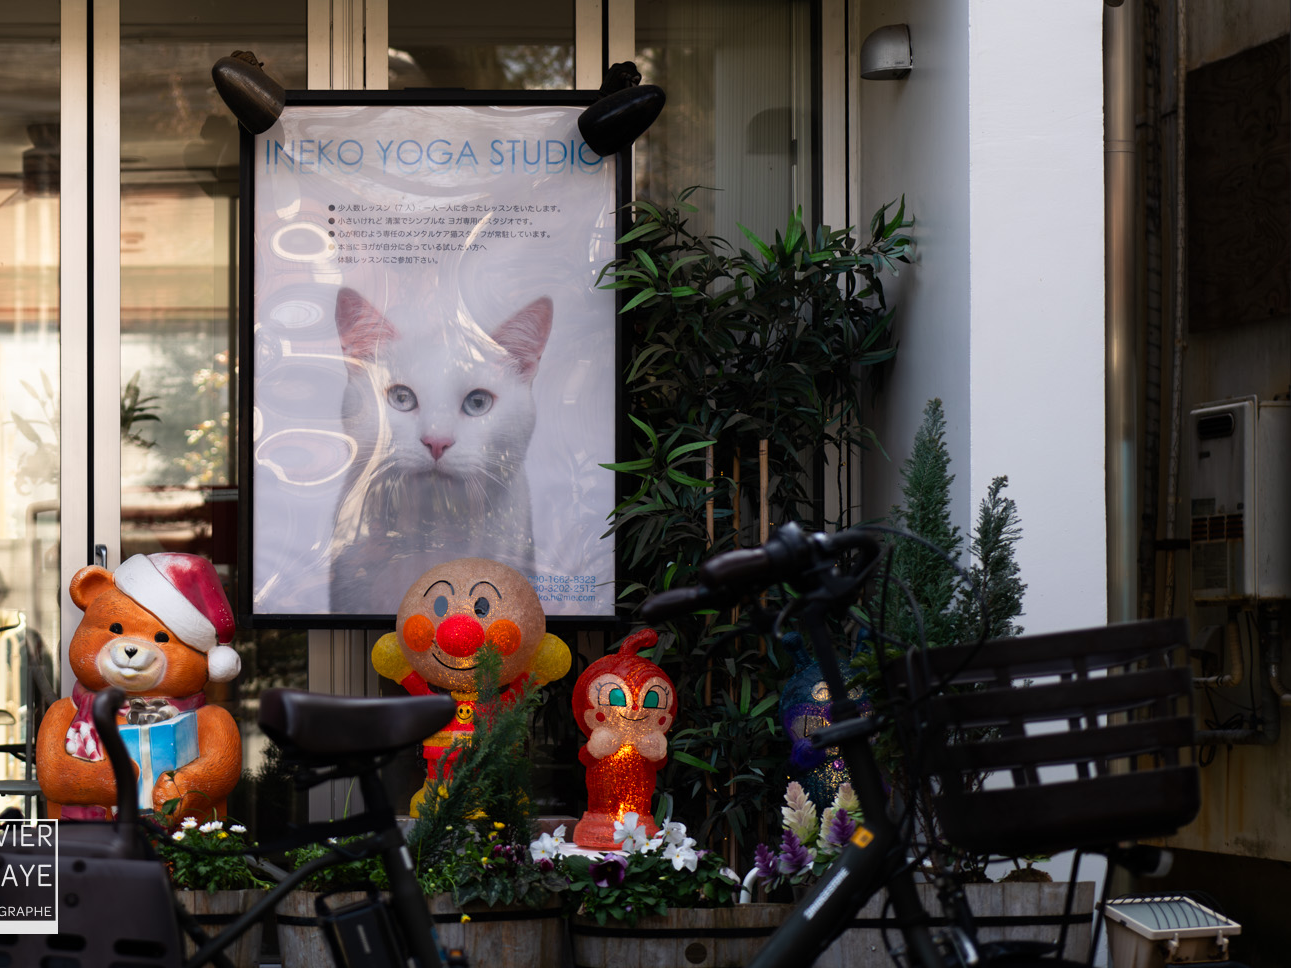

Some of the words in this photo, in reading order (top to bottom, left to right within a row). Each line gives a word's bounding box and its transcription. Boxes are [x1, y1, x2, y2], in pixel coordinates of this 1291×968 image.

[266, 139, 364, 166] INEKO
[376, 139, 478, 166] YOGA
[489, 139, 604, 166] STUDIO
[337, 230, 551, 239] 心が和むよう専任のメンタルケア猫スタフが常駐しています。
[532, 584, 596, 592] 80-3202-2512
